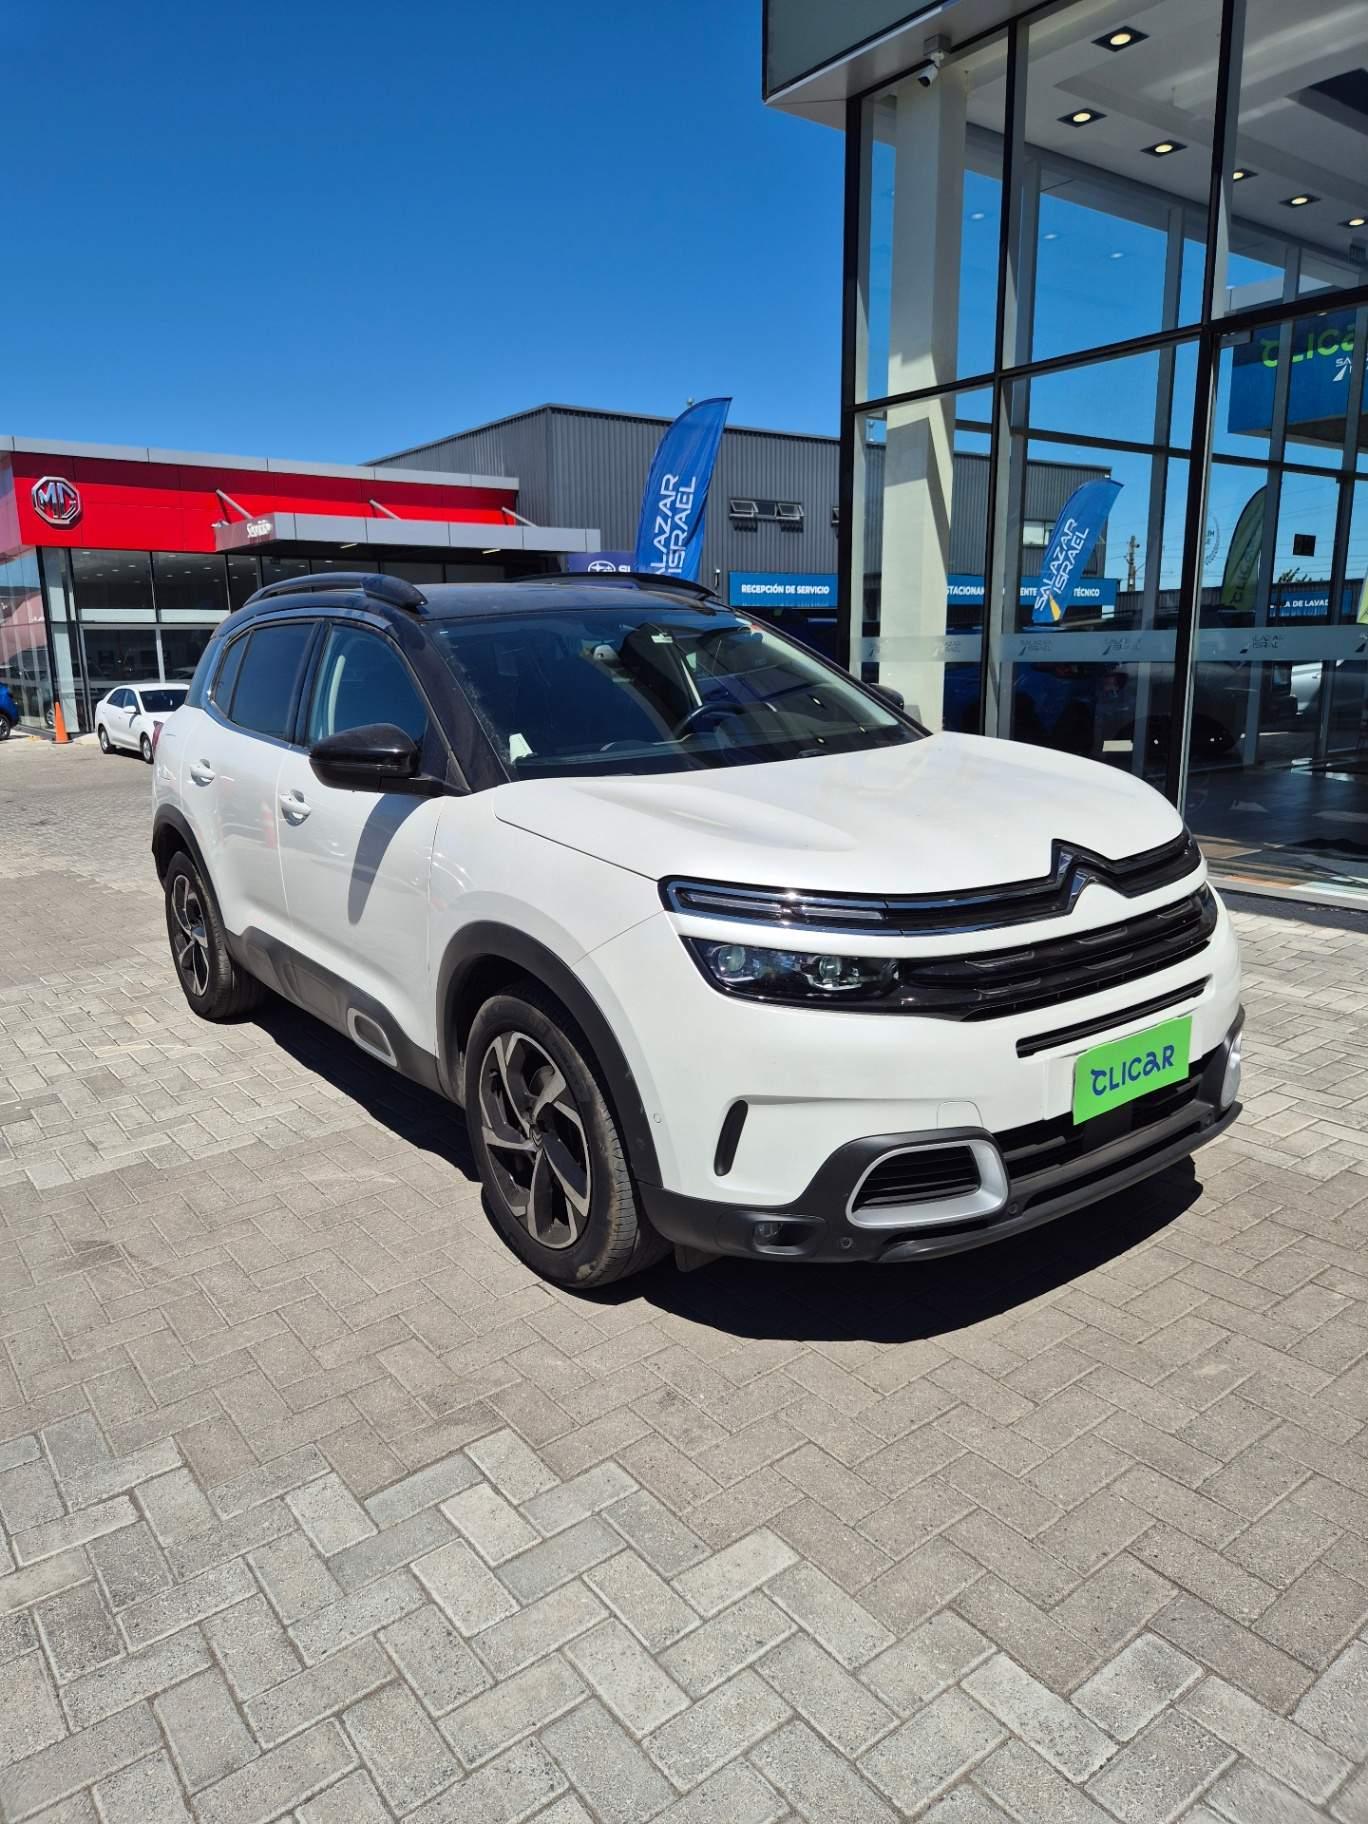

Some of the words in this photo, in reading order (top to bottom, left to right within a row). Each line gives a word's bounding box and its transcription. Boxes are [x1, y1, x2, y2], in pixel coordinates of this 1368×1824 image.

[37, 481, 77, 519] MG
[650, 473, 679, 575] LAZAR
[668, 476, 696, 573] ISRAEL
[741, 582, 785, 594] RECEPCIÓN
[785, 584, 796, 594] DE
[796, 584, 830, 595] SERVICIO
[1020, 586, 1038, 597] ENTE
[1034, 518, 1077, 612] SALAZAR
[1053, 527, 1089, 594] ISRAEL
